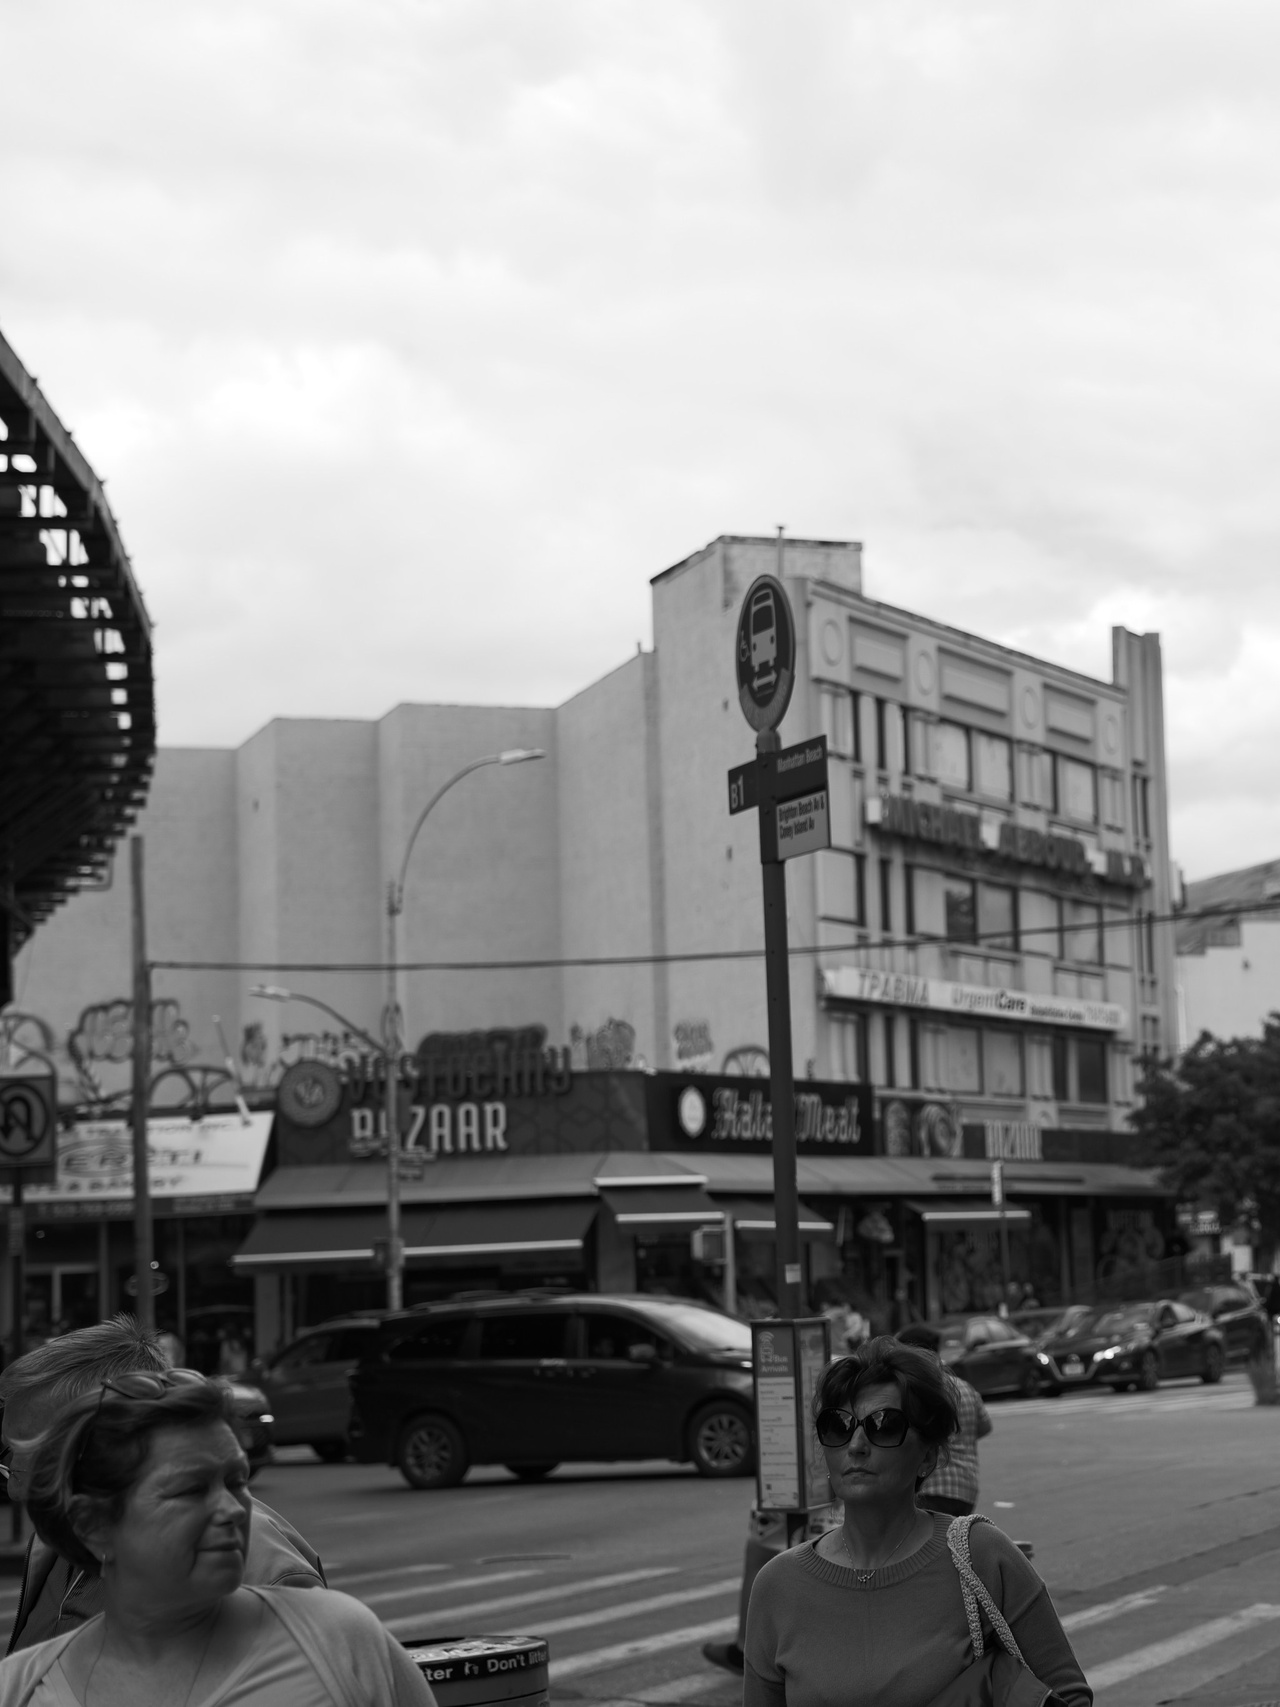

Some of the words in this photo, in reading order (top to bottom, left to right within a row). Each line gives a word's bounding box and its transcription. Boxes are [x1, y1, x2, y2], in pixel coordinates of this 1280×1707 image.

[731, 774, 745, 810] B1
[350, 1102, 507, 1158] BZAAR
[421, 1667, 453, 1682] ter
[487, 1654, 526, 1673] Don't
